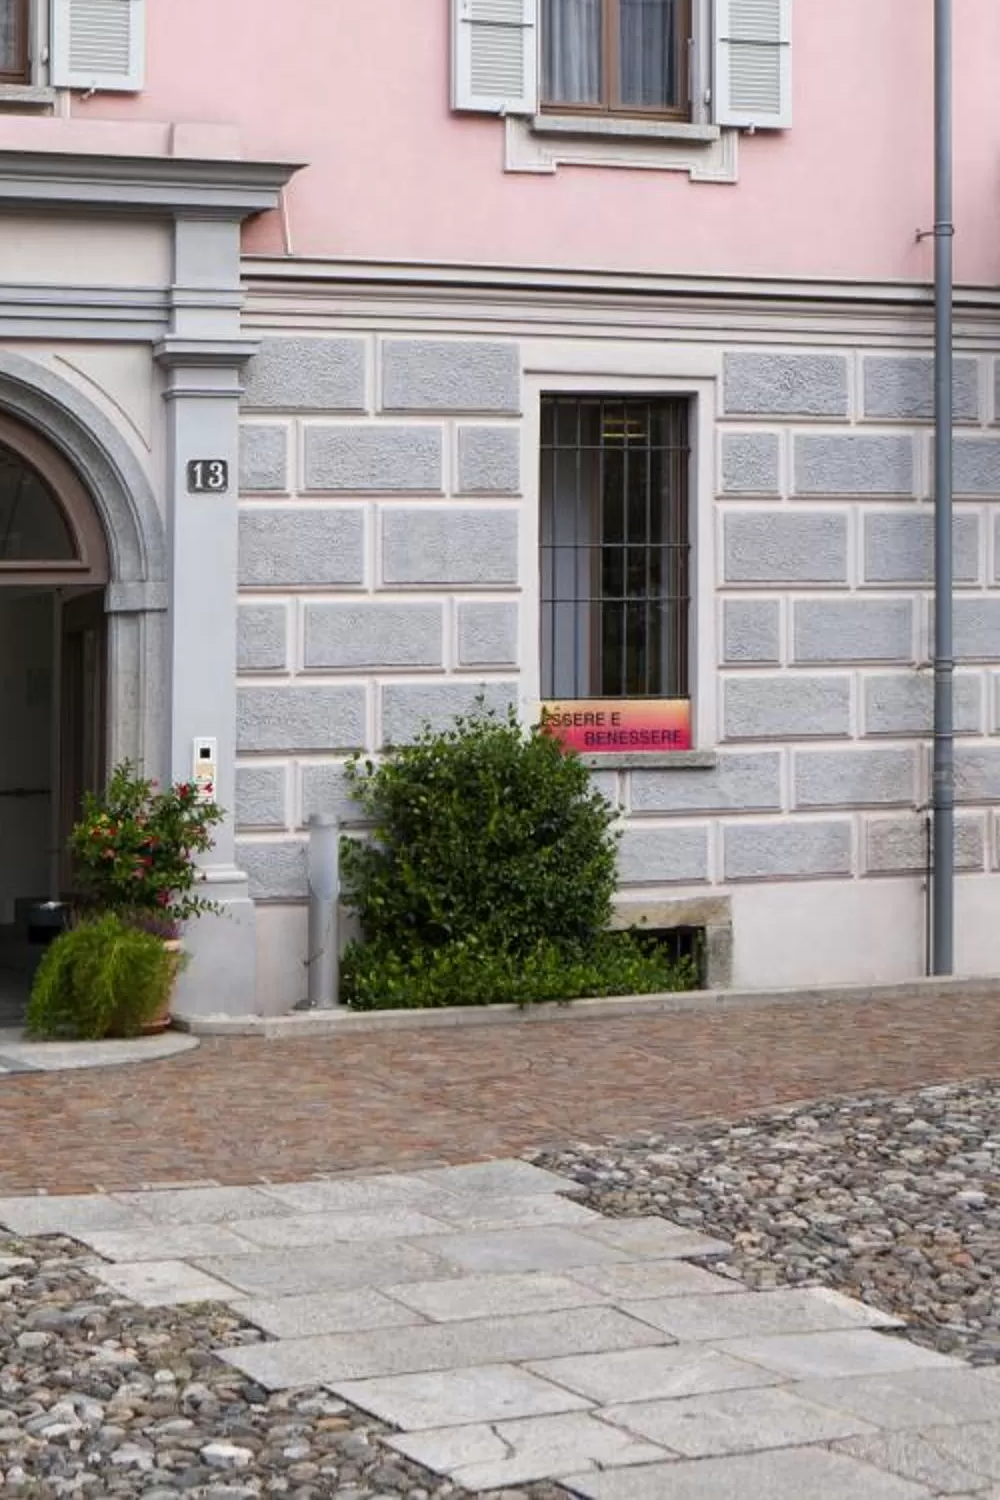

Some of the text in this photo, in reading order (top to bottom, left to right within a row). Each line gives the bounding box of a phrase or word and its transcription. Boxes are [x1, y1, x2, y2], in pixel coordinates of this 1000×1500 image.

[192, 461, 225, 488] 13
[611, 711, 621, 726] E
[584, 729, 681, 746] BENESSERE
